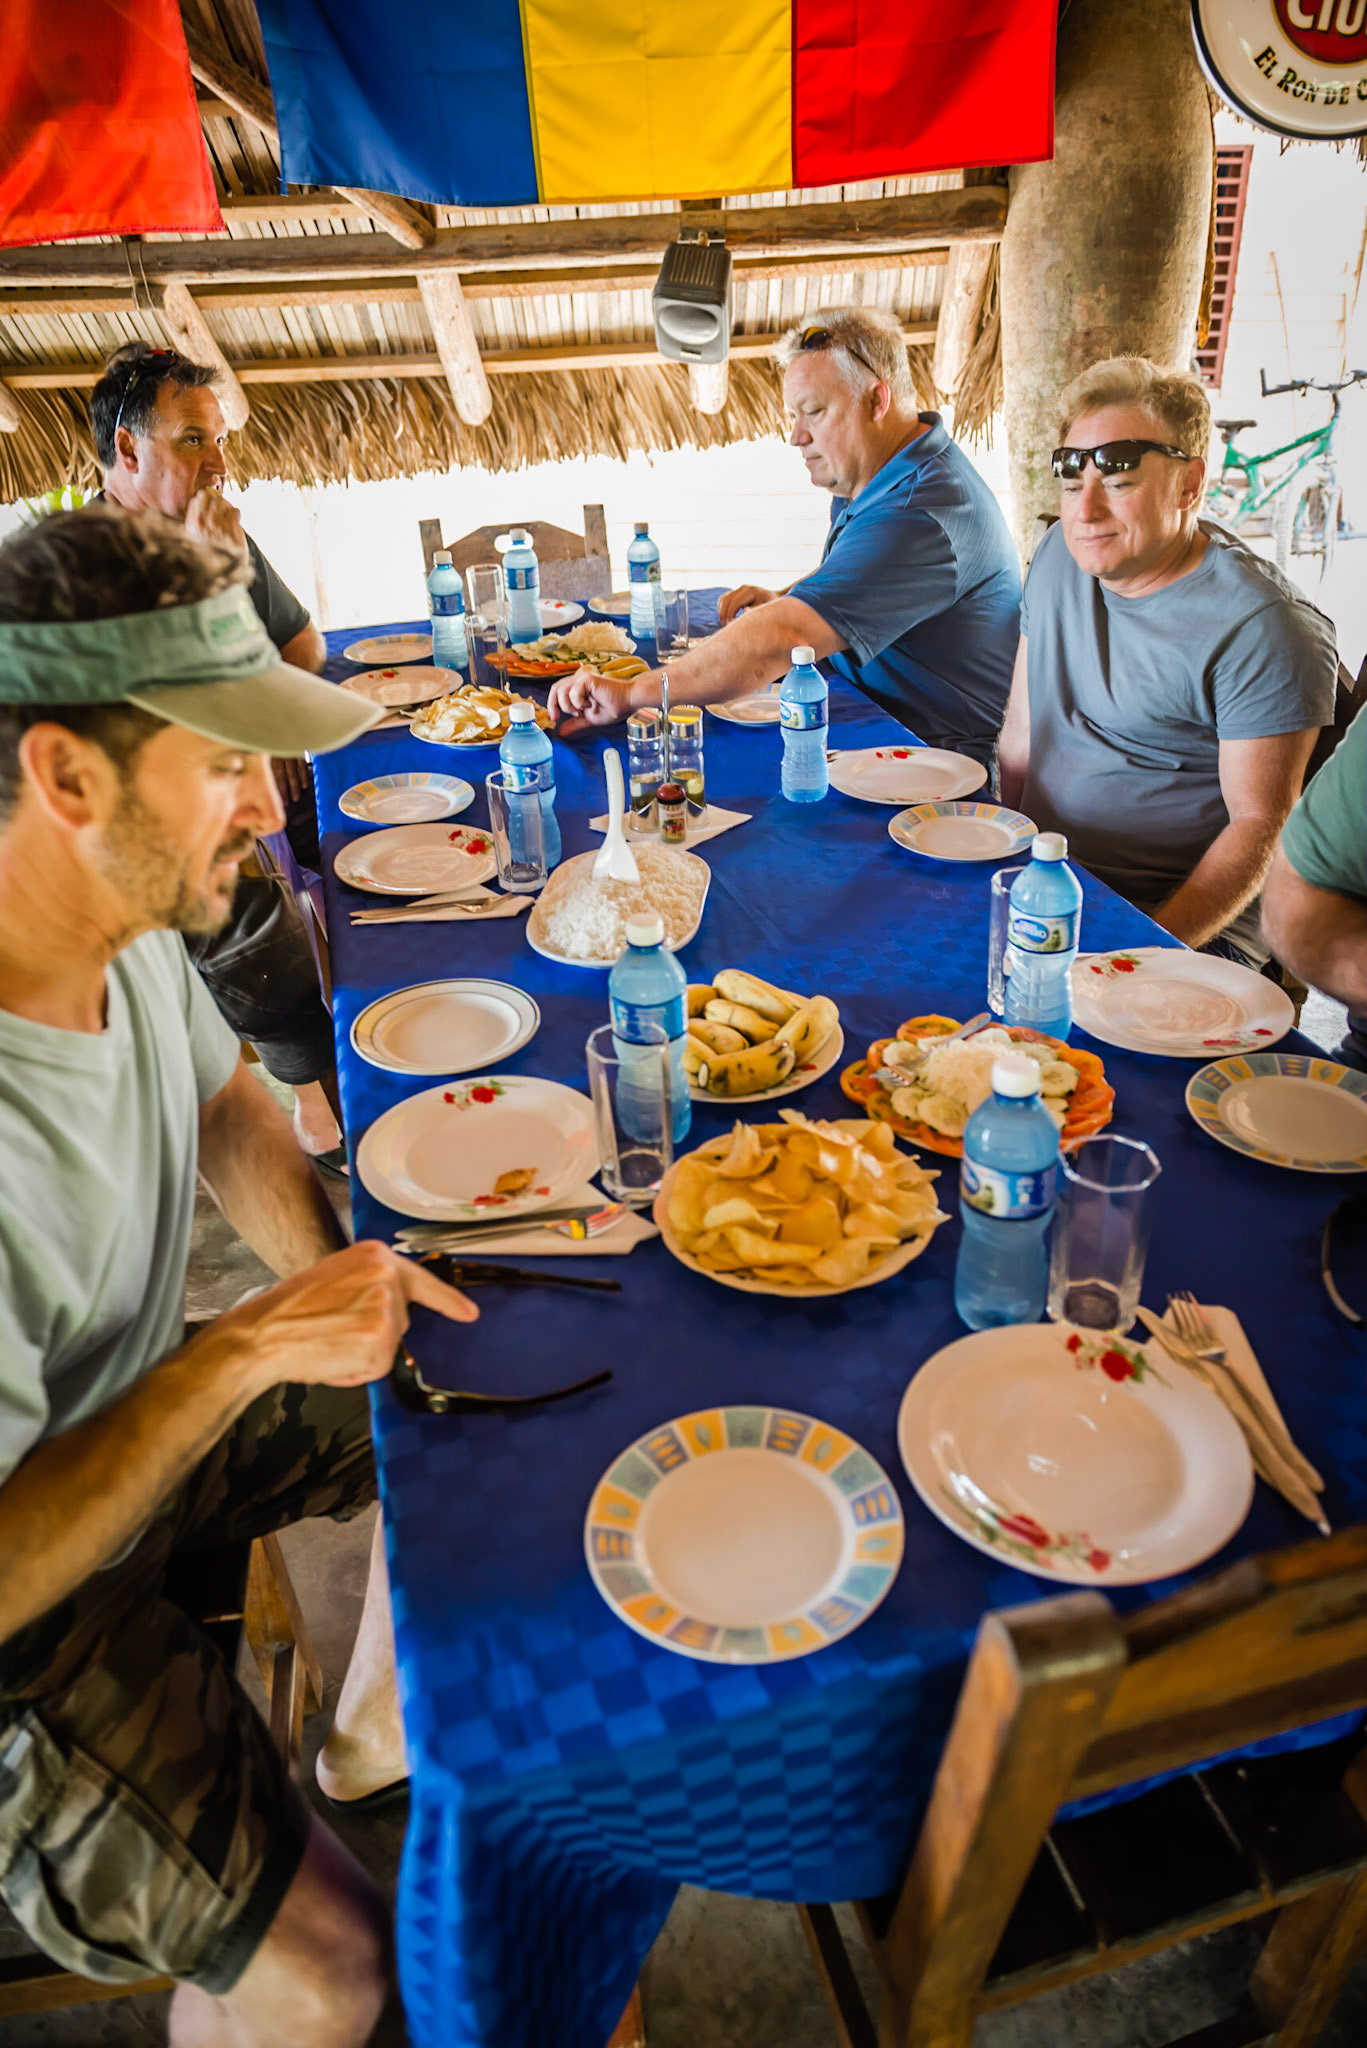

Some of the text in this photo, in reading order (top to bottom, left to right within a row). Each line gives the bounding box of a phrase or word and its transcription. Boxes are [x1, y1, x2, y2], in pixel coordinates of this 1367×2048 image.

[1254, 45, 1278, 79] EL
[1277, 67, 1319, 103] RON
[1324, 87, 1350, 105] DE
